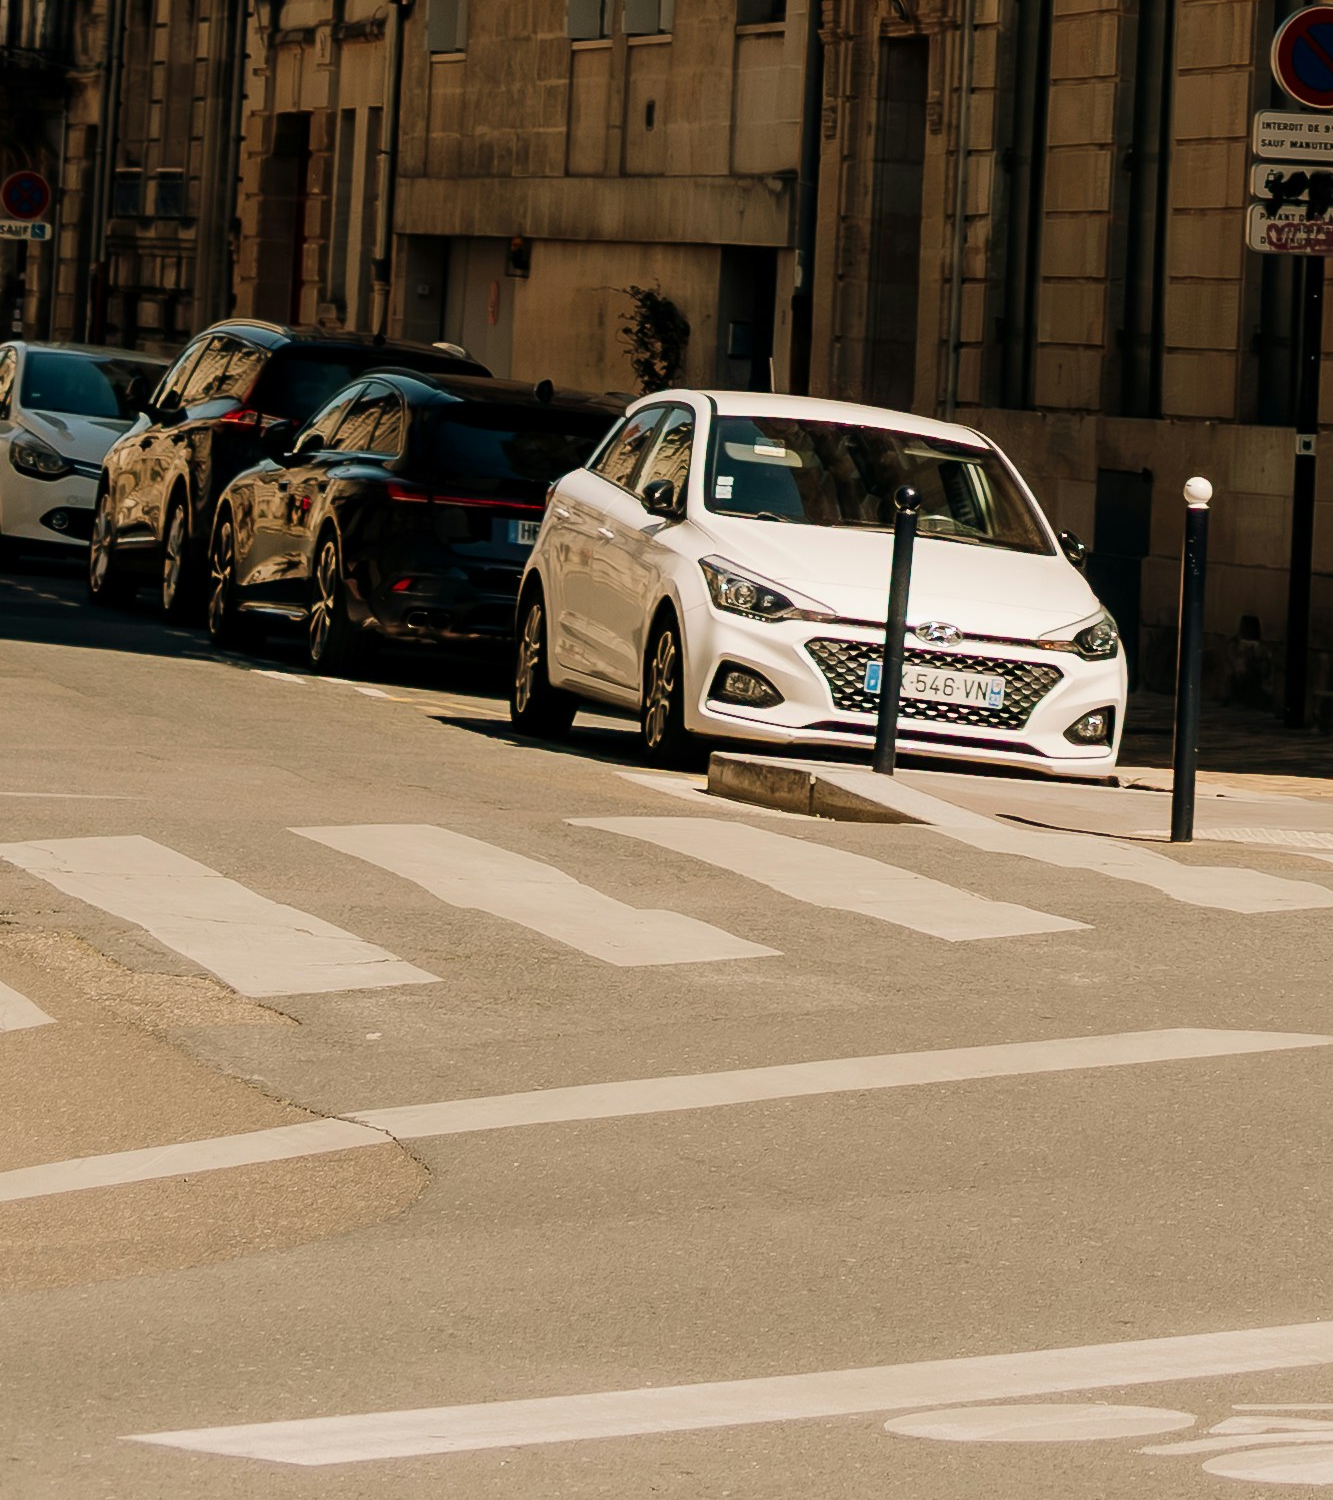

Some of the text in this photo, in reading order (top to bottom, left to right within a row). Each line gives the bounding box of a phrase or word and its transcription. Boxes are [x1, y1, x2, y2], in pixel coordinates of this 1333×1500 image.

[1262, 121, 1304, 133] INTERDIT
[1308, 123, 1320, 133] DE
[1260, 138, 1285, 148] SAUF
